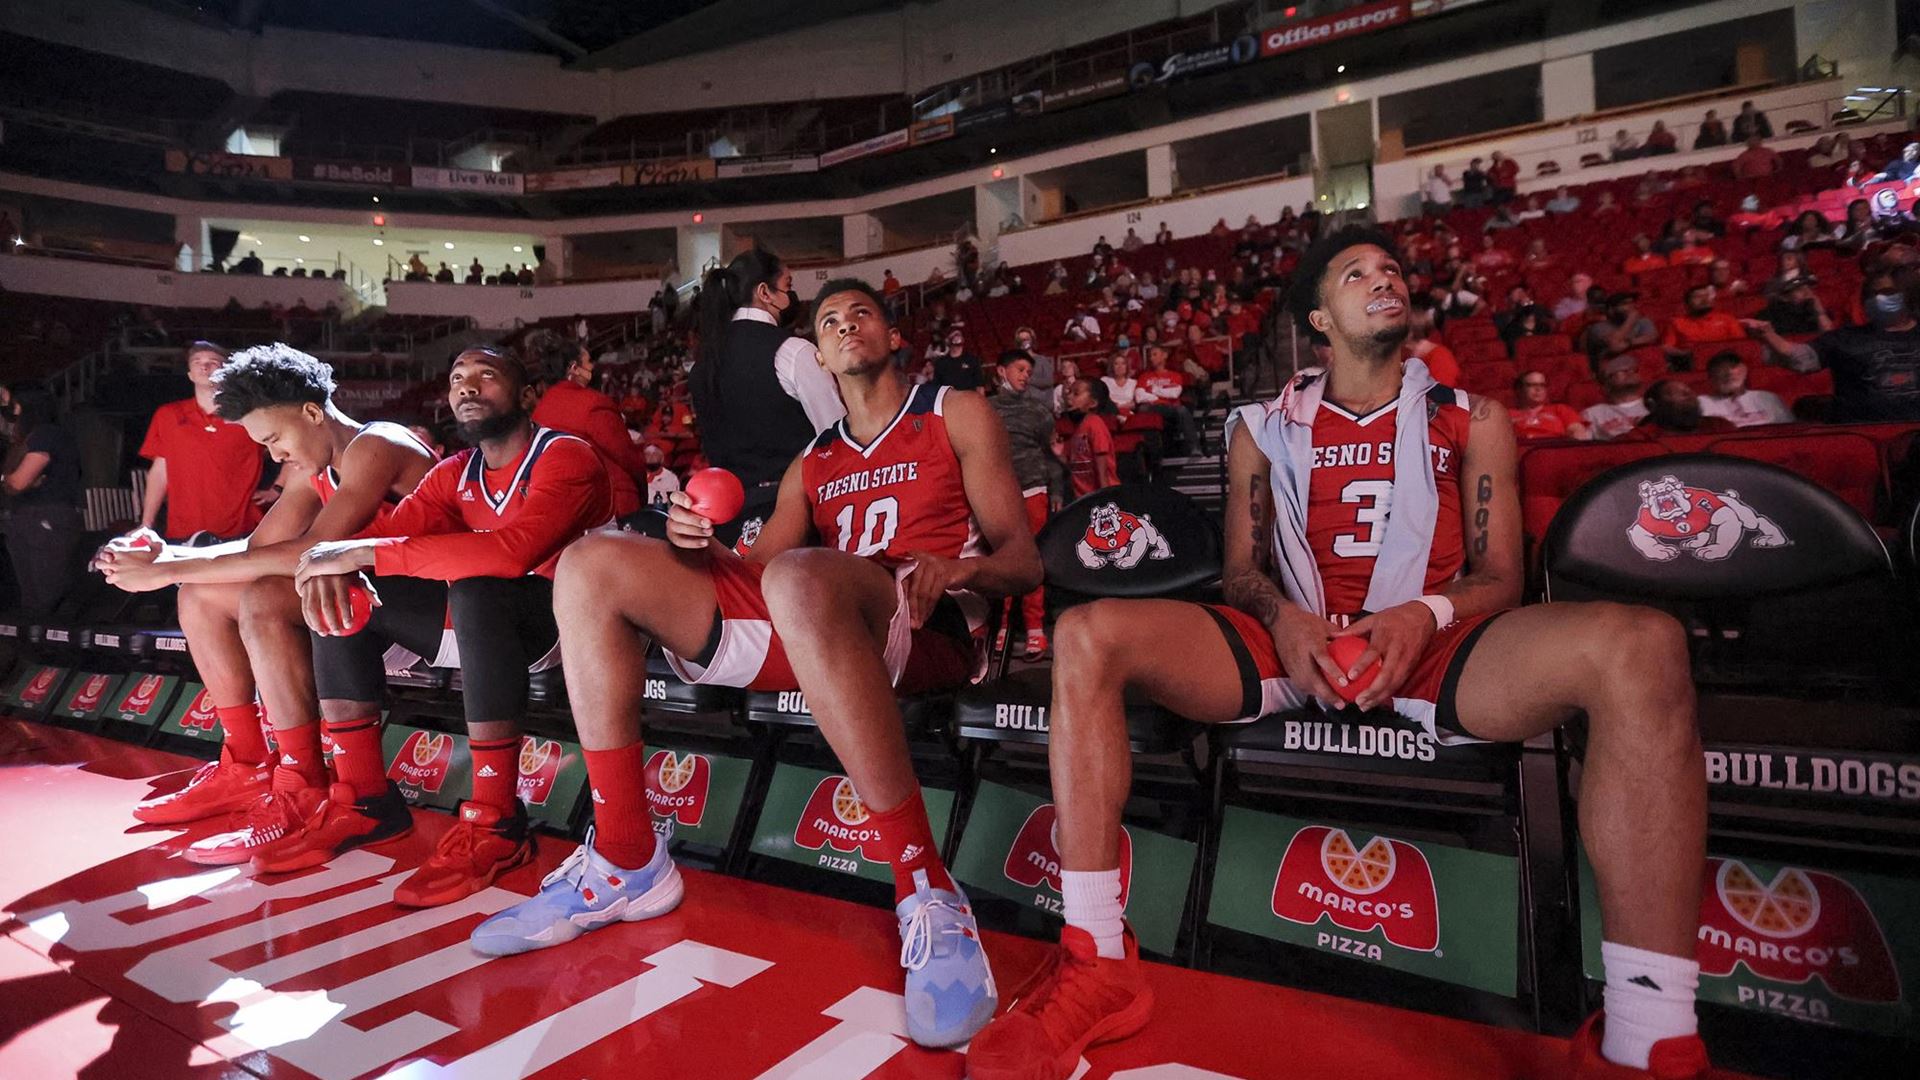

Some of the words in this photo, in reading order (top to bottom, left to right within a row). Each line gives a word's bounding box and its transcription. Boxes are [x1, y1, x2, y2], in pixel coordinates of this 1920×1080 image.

[1266, 23, 1331, 49] Office
[1333, 5, 1401, 33] DEPOT
[313, 163, 393, 183] #BeBold
[449, 171, 479, 183] Live
[484, 173, 516, 186] Well
[1311, 442, 1372, 469] ESNO
[817, 470, 869, 504] FRESNO
[871, 461, 919, 488] STATE
[835, 495, 899, 556] 10
[1332, 479, 1395, 558] 3
[995, 703, 1050, 731] BULL
[1283, 720, 1436, 762] BULLDOGS
[398, 761, 439, 777] MARCO'S
[518, 777, 545, 787] RCO'S
[1703, 750, 1920, 799] BULLDOGS
[645, 788, 695, 807] MARCO'S
[812, 816, 882, 842] MARCO'S
[818, 853, 858, 873] PIZZA
[1297, 881, 1415, 920] MARCO'S
[1316, 930, 1383, 961] PIZZA
[1697, 924, 1860, 967] MARCO'S
[1737, 984, 1830, 1019] PIZZA
